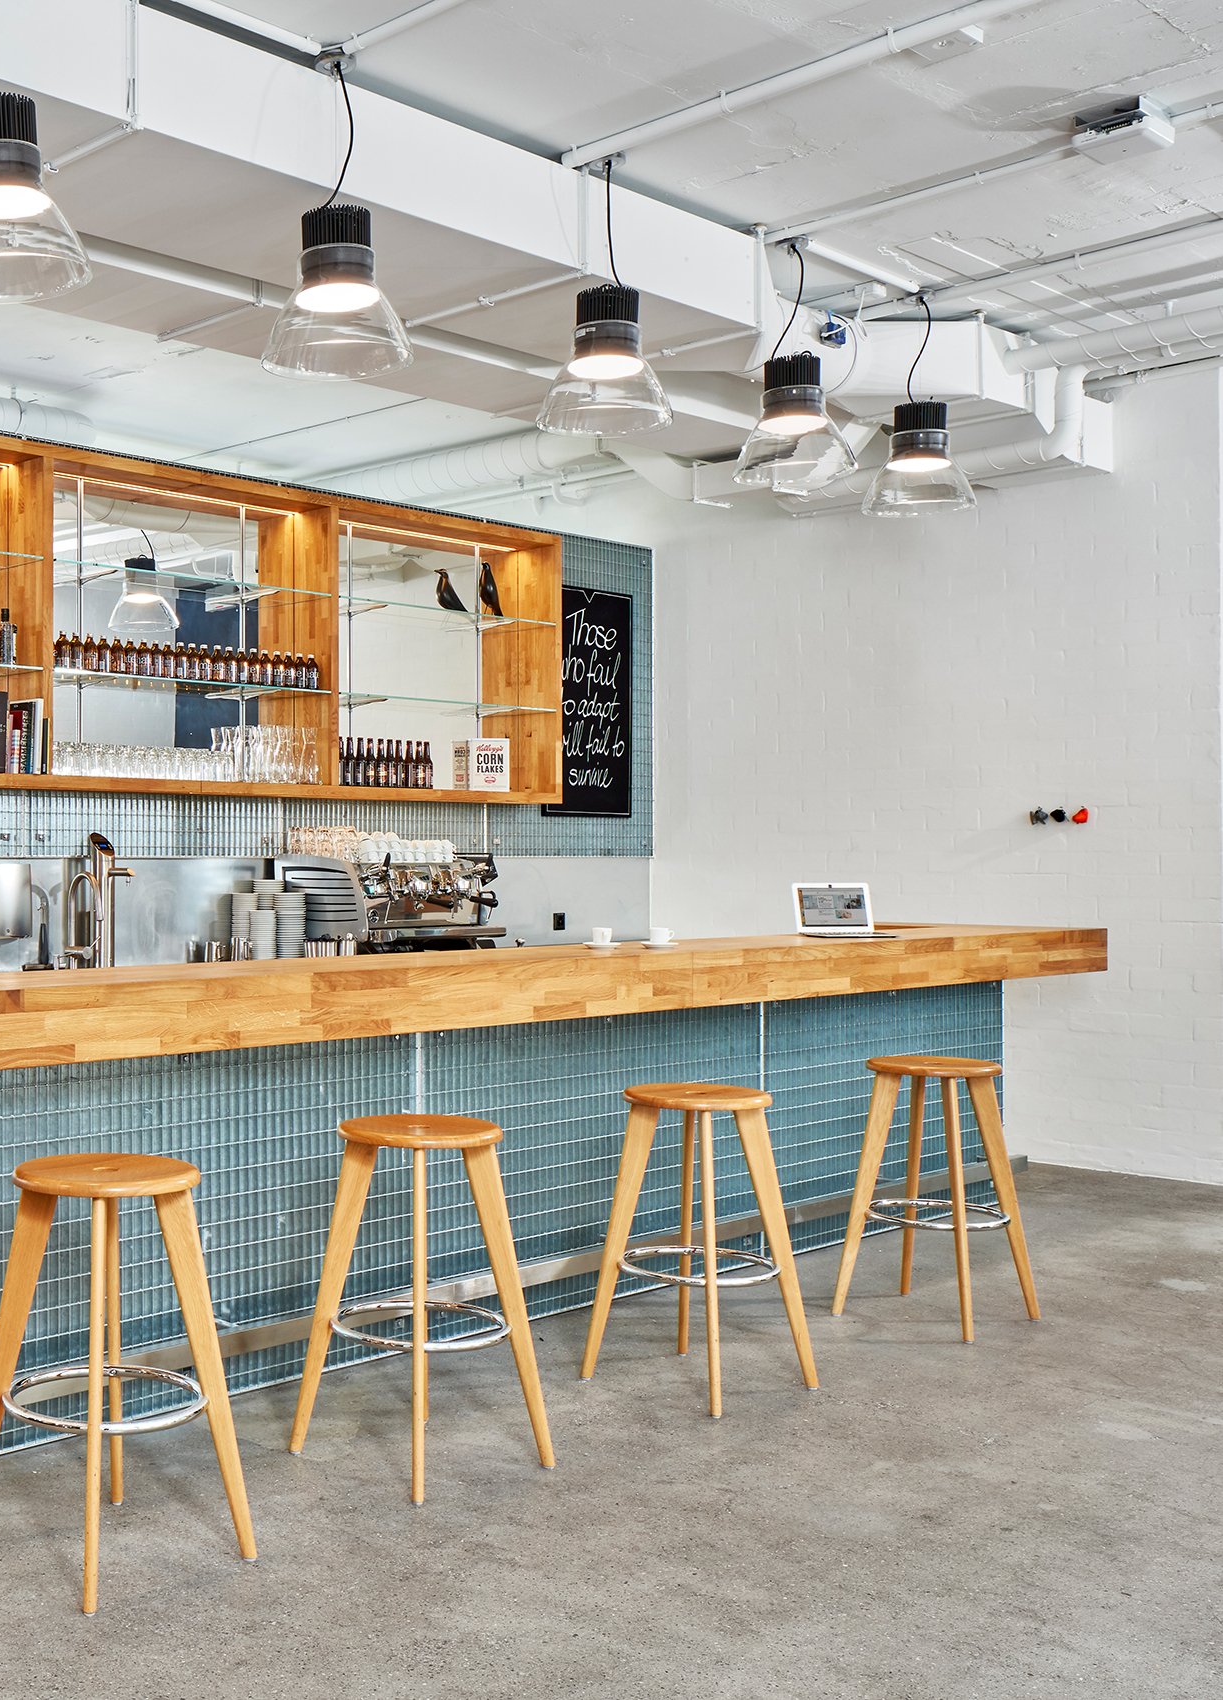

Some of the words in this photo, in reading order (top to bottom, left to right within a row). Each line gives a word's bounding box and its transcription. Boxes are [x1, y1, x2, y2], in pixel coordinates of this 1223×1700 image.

[565, 608, 617, 650] Those
[586, 649, 622, 697] fail
[577, 691, 621, 730] adapt
[476, 753, 504, 765] CORN
[585, 724, 611, 762] fail
[612, 725, 625, 757] to
[476, 765, 504, 773] FLAKES
[568, 762, 614, 788] survive
